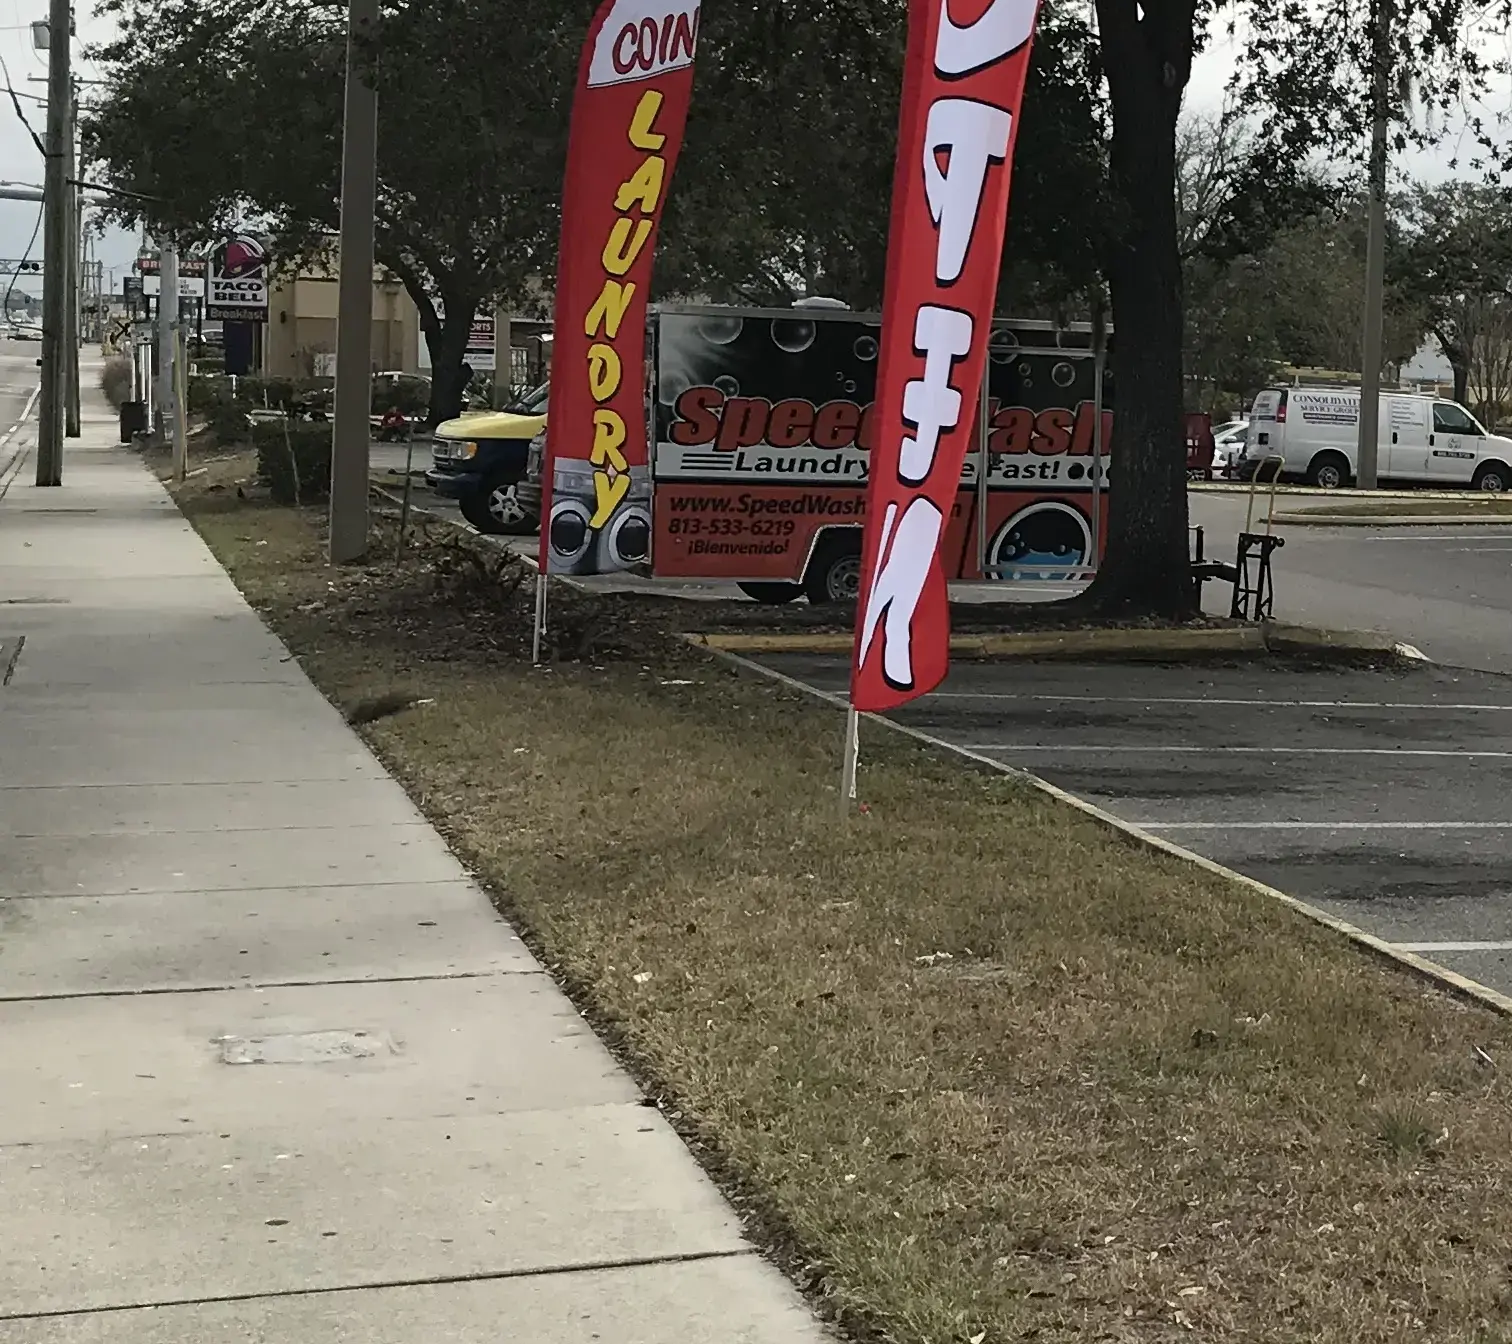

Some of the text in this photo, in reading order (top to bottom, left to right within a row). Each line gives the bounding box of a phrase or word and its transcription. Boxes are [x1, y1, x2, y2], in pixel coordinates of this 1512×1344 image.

[612, 6, 700, 75] COIN
[211, 280, 263, 292] TACO
[214, 292, 263, 302] BELL
[210, 307, 264, 320] Breakfast
[583, 89, 667, 530] LAUNDRY
[1292, 394, 1360, 406] CONSOLIDATE
[735, 452, 869, 480] Laundry
[668, 517, 796, 537] 813-533-6219
